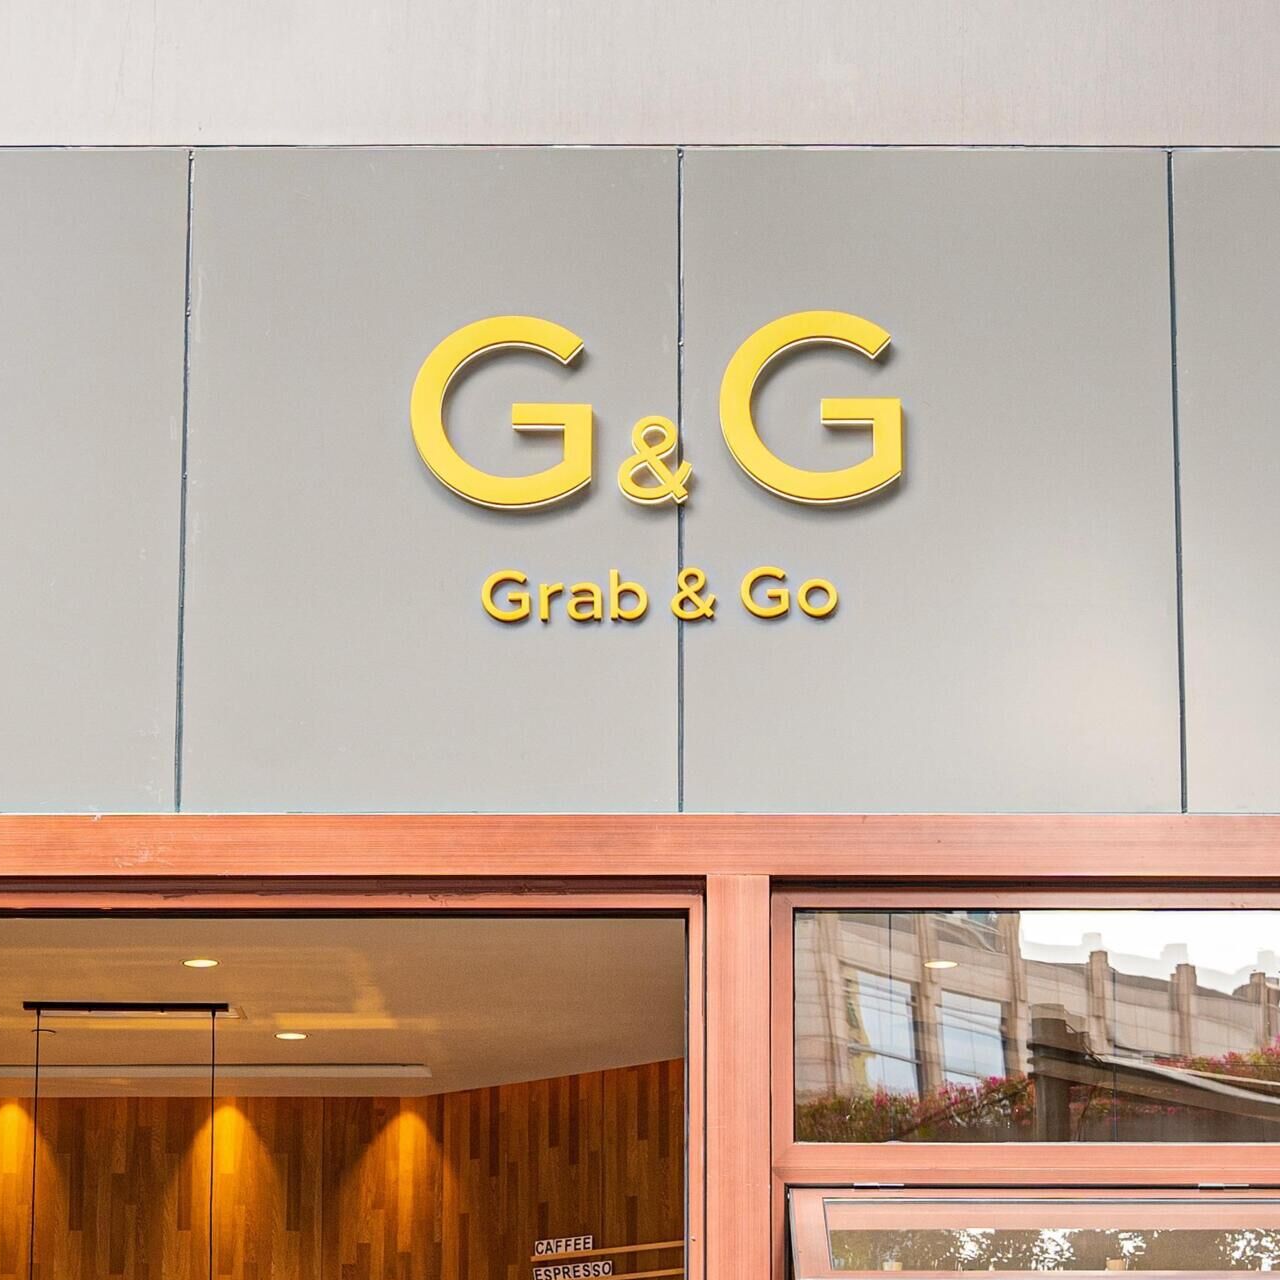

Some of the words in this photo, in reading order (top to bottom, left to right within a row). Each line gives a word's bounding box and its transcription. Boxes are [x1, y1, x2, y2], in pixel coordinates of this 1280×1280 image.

[481, 569, 648, 622] Grab
[670, 568, 717, 621] &
[740, 566, 838, 619] Go
[536, 1237, 591, 1254] CAFFEE
